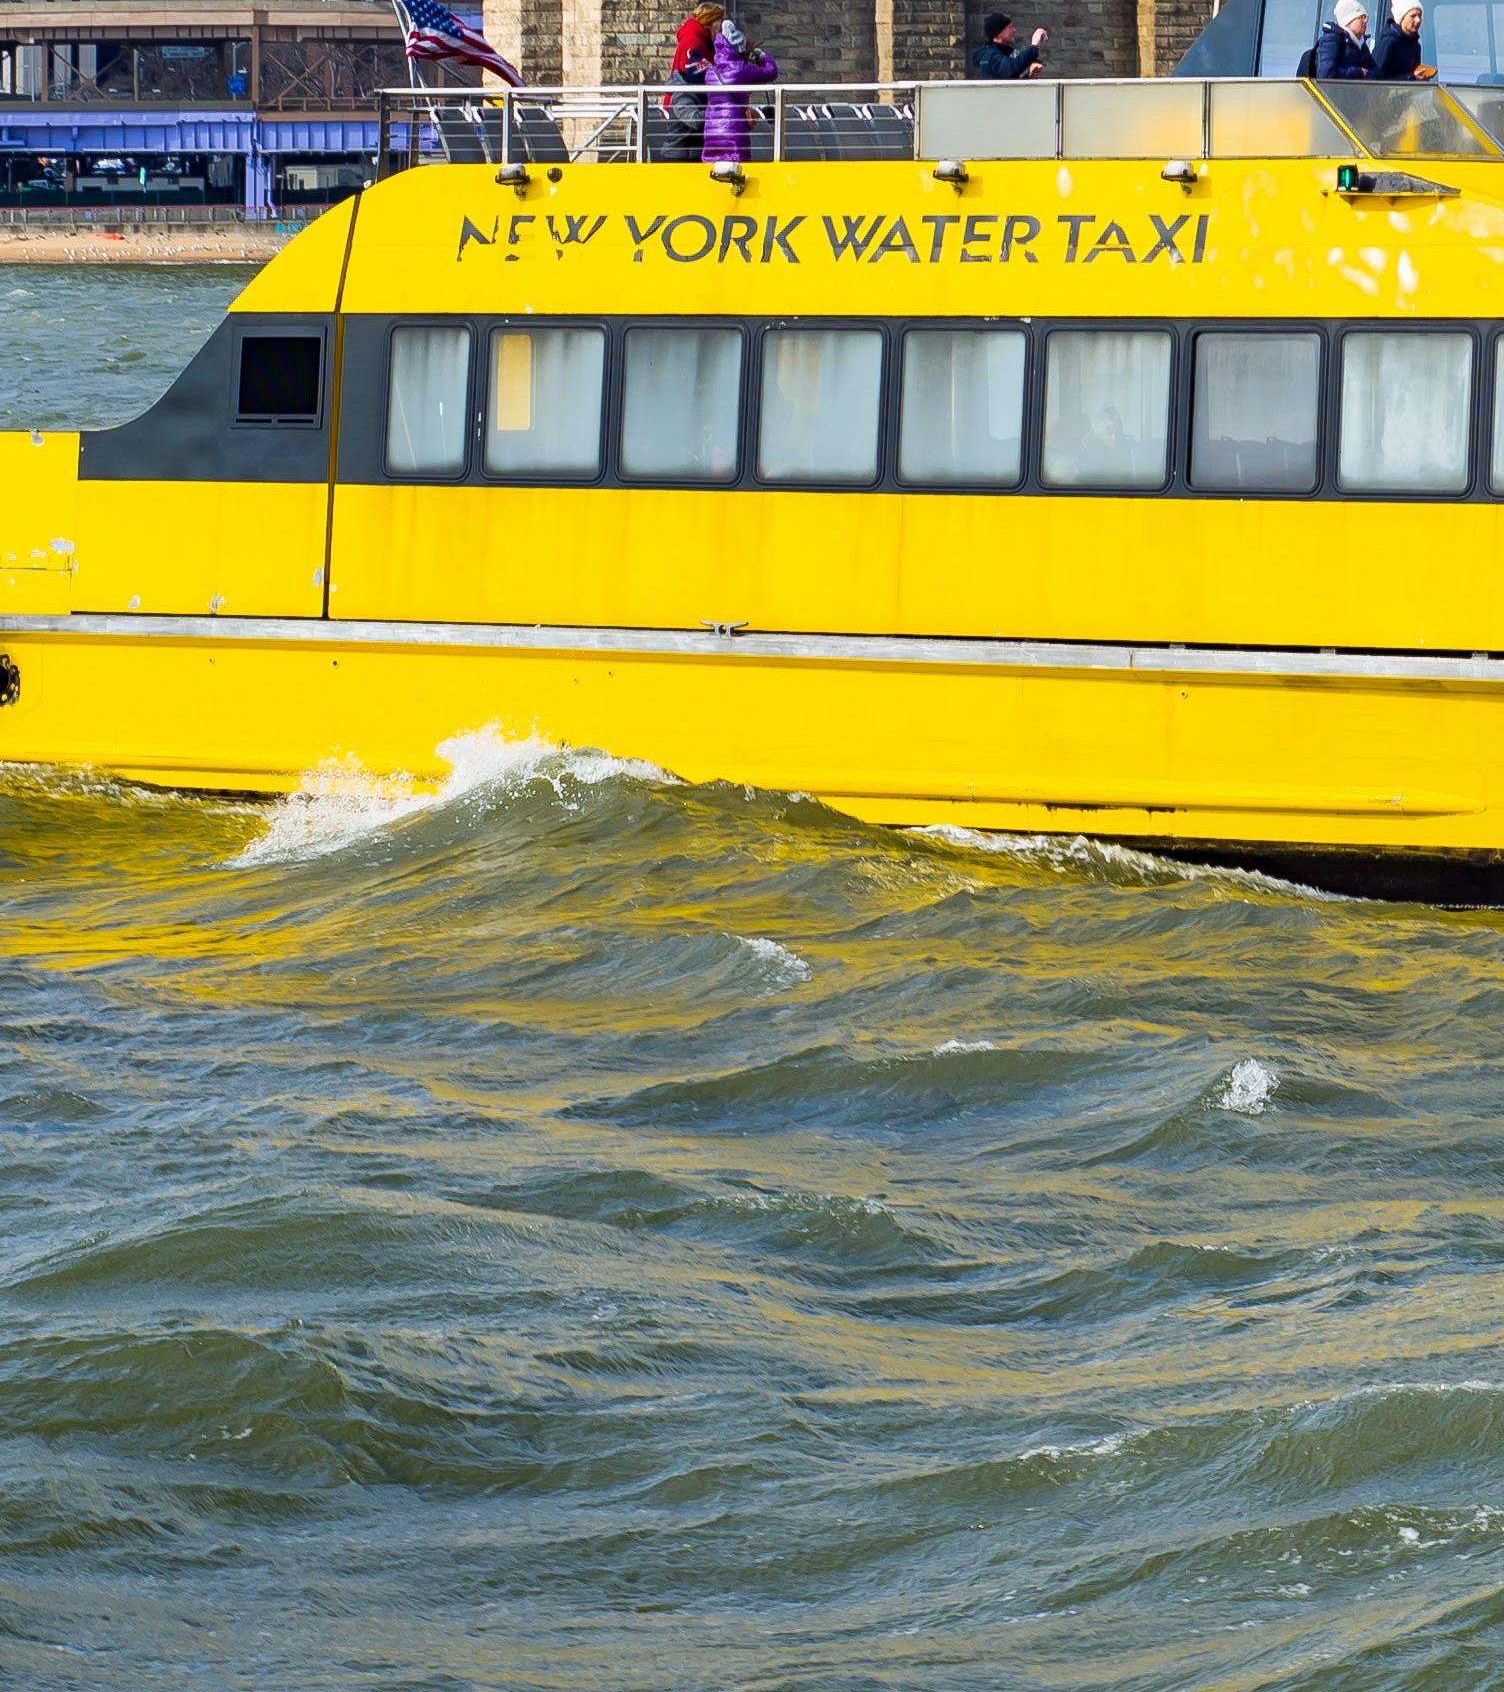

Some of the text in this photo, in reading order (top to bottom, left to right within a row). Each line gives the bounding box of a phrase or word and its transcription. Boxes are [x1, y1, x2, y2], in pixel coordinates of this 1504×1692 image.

[623, 214, 808, 264] YORK
[821, 214, 1042, 264] WATER
[1057, 214, 1210, 264] TAXI
